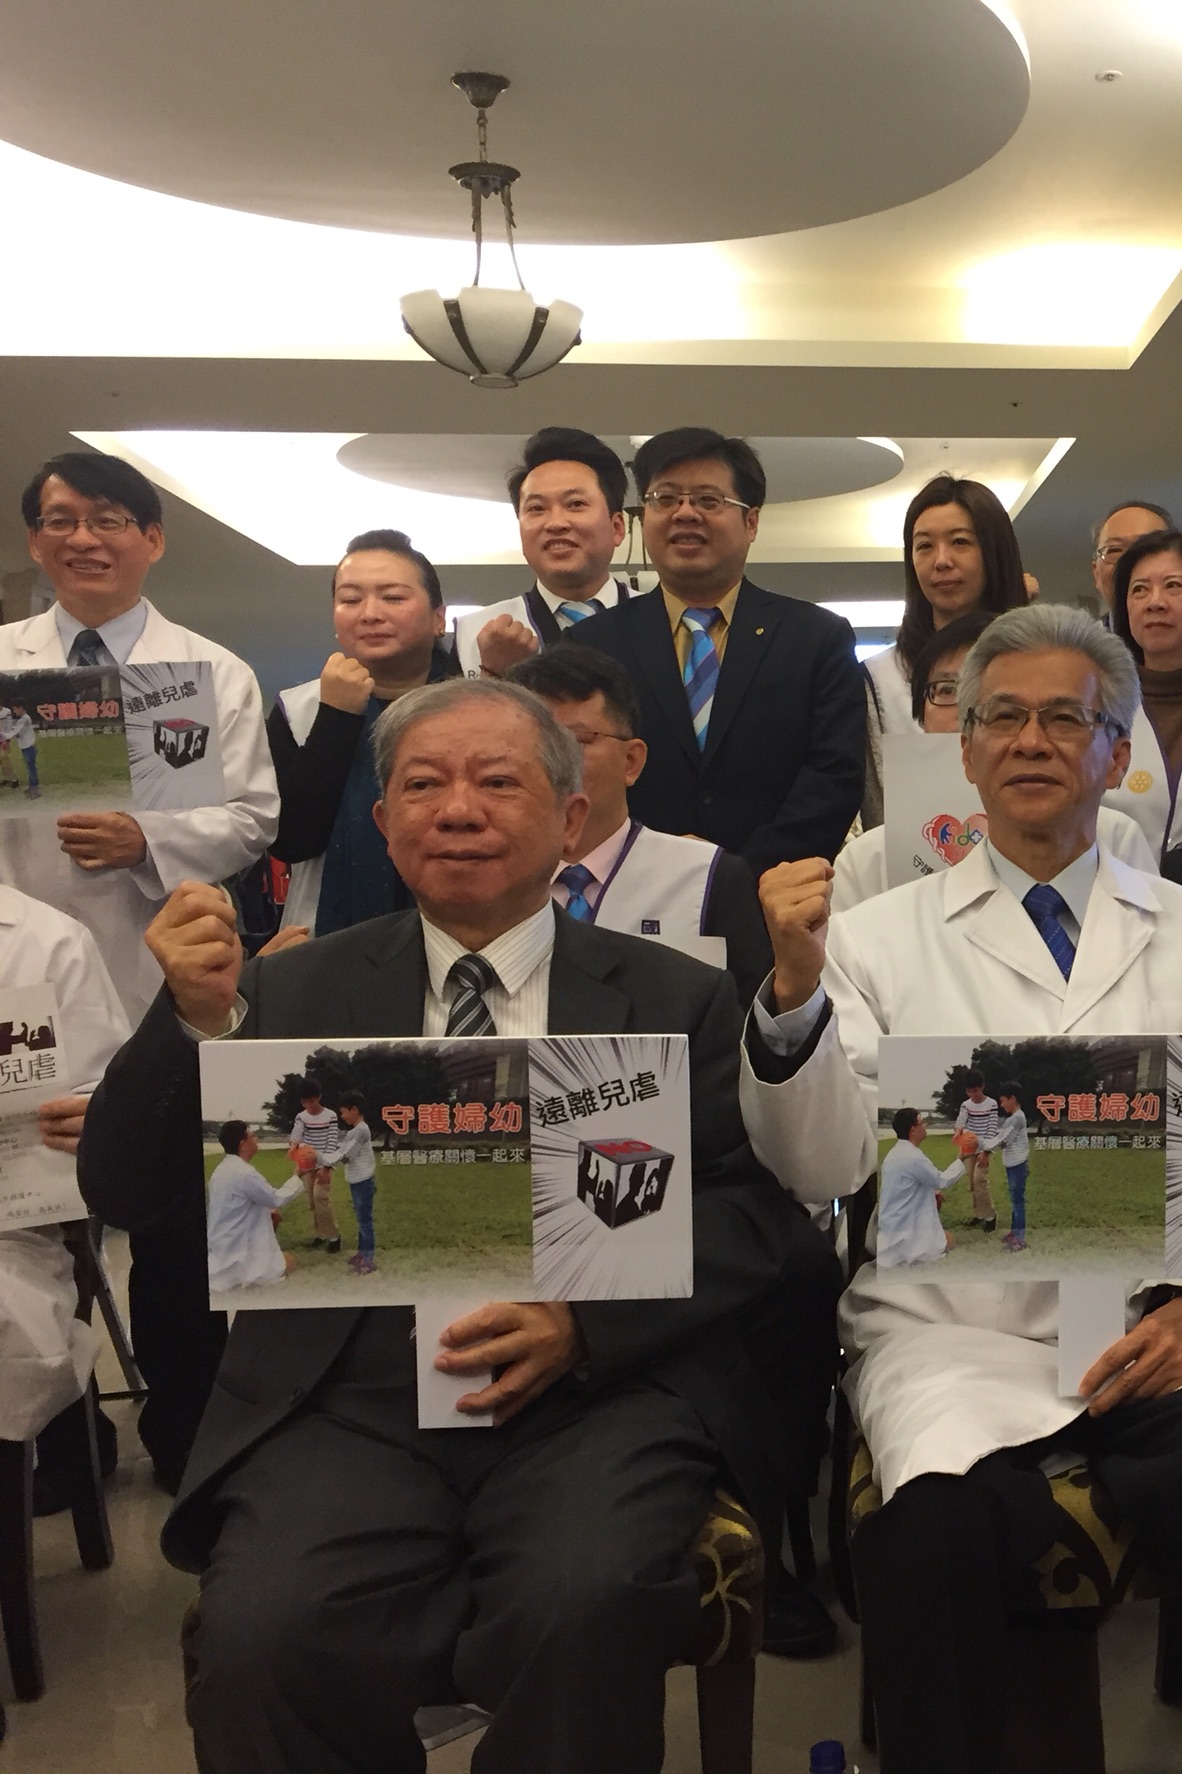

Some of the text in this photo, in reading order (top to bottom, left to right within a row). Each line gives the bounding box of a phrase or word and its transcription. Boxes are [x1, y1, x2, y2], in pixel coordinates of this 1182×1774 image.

[127, 680, 198, 715] 遠離兒虐
[535, 1071, 660, 1128] 遠離兒虐
[1036, 1092, 1160, 1122] 守護婦幼
[381, 1101, 523, 1135] 守護婦幼
[380, 1149, 526, 1166] 基層醫療關懷一起來
[1034, 1136, 1161, 1151] 基層醫療關懷一起來
